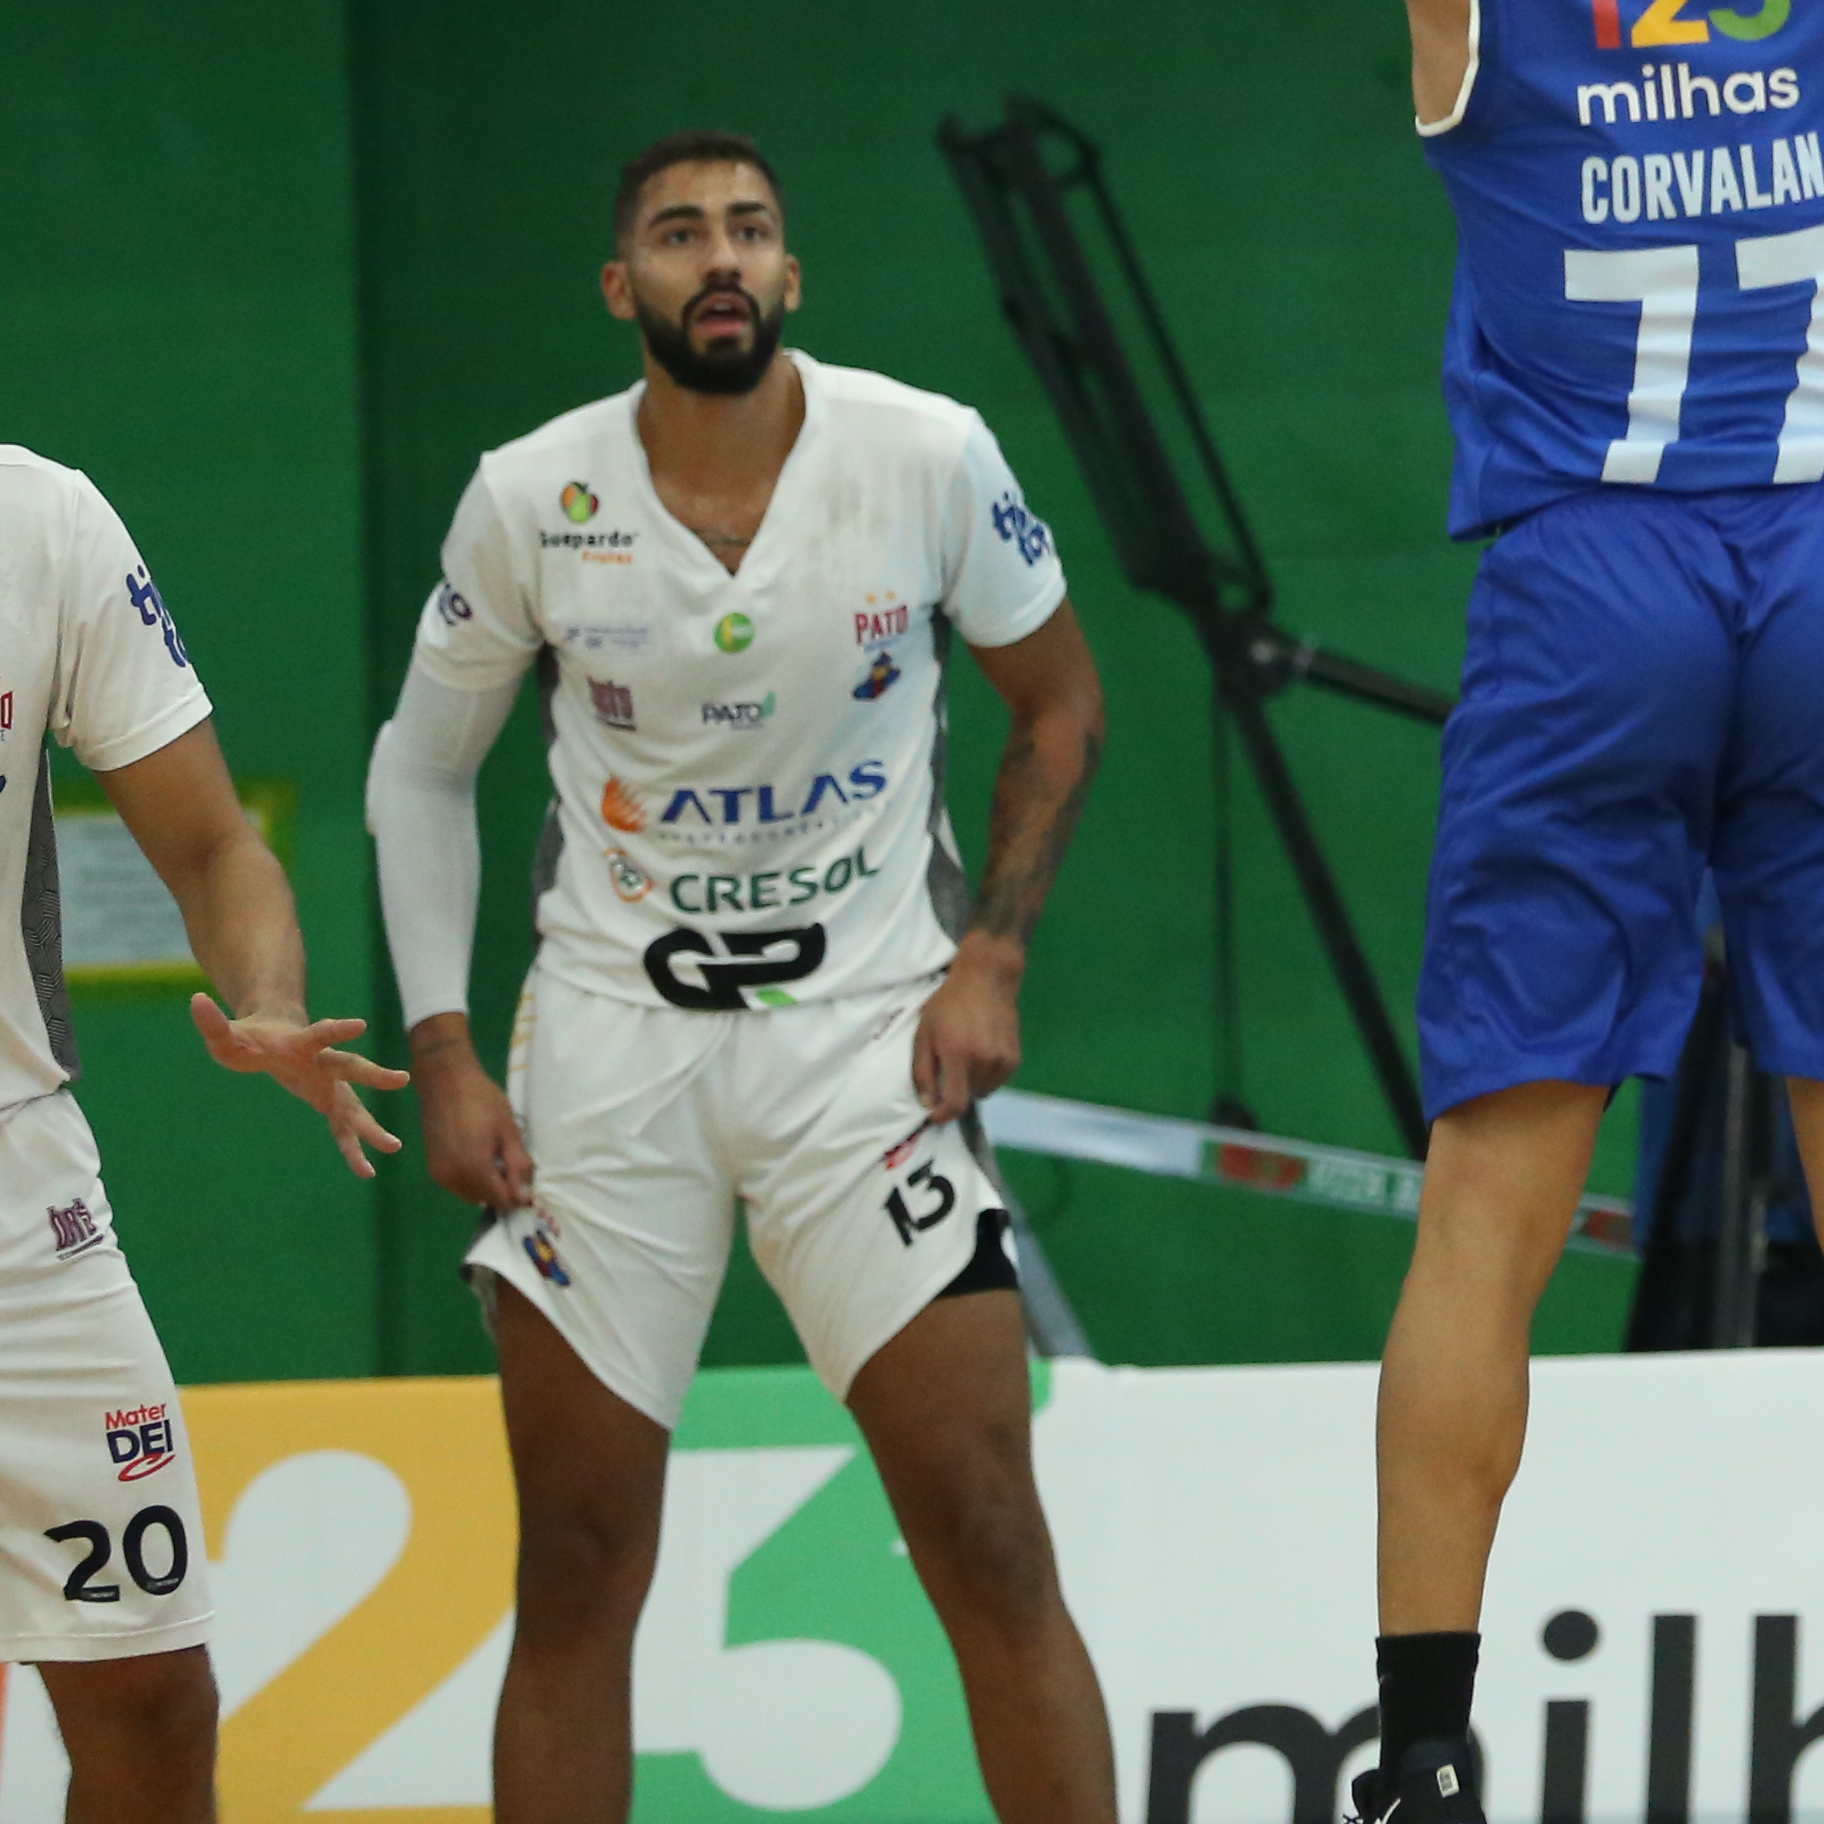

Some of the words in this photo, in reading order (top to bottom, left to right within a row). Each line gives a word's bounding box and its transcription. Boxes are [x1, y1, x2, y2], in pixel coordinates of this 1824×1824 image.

[1577, 62, 1800, 125] milhas
[854, 606, 907, 644] PATO
[661, 760, 888, 824] ATLAS
[669, 845, 880, 913] CRESOL
[882, 1157, 956, 1248] 13
[103, 1402, 167, 1431] Mater
[106, 1419, 175, 1465] DEI
[43, 1504, 188, 1603] 20
